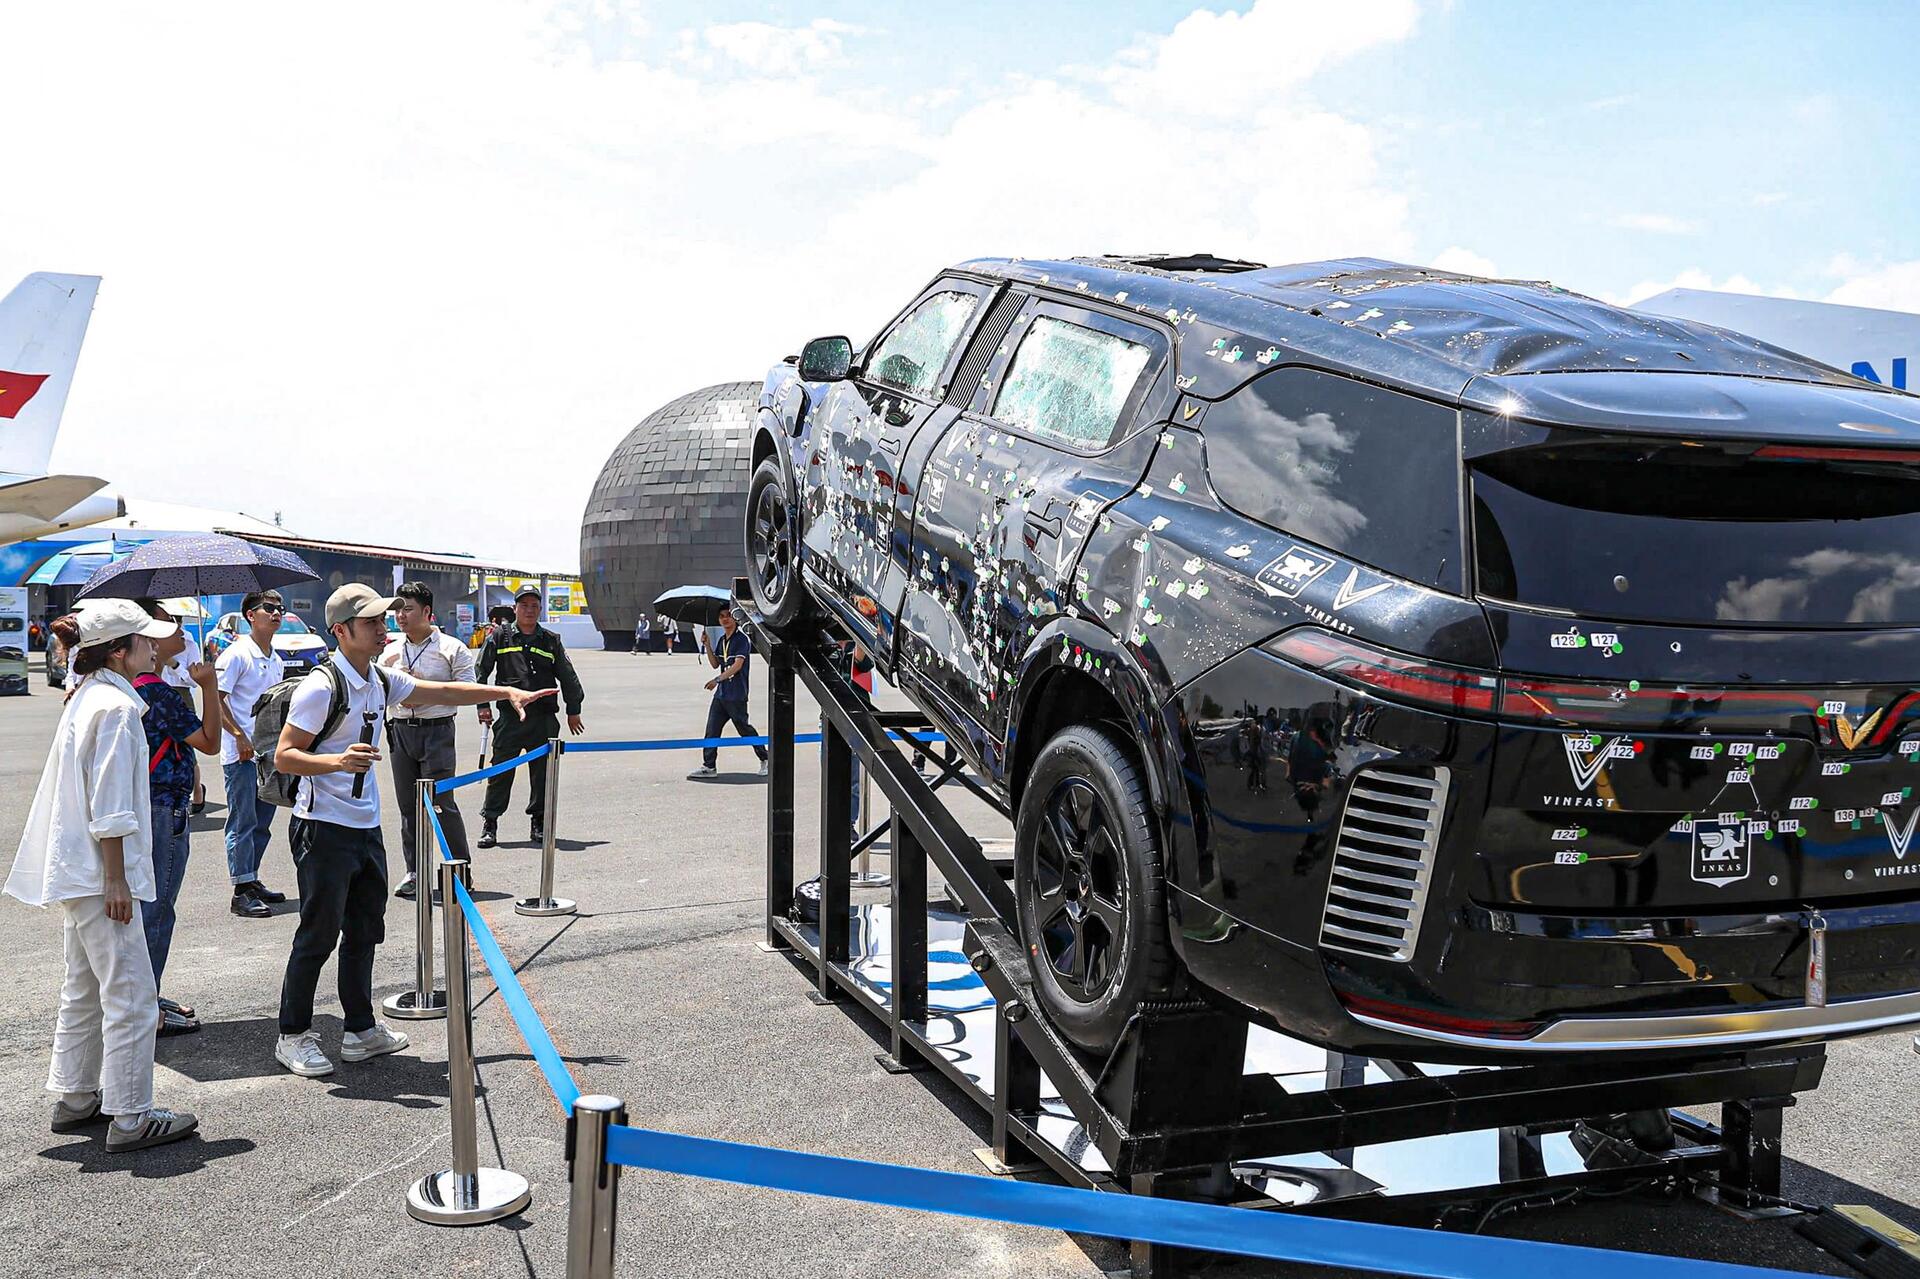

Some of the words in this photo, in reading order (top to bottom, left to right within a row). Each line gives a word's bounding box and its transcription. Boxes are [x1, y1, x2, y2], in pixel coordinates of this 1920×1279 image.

[1264, 571, 1297, 590] INKAS
[1304, 603, 1356, 634] VINFAST
[1554, 635, 1576, 646] 128
[1594, 634, 1615, 645] 127
[1826, 702, 1843, 713] 119
[1570, 740, 1591, 751] 123
[1732, 744, 1750, 755] 121
[1901, 742, 1917, 752] 139
[1613, 746, 1633, 757] 122
[1695, 748, 1712, 758] 115
[1760, 747, 1777, 758] 116
[1826, 764, 1842, 774] 120
[1730, 772, 1748, 782] 109
[1543, 795, 1616, 808] VINFAST
[1793, 799, 1809, 809] 112
[1884, 794, 1900, 804] 135
[1721, 813, 1737, 824] 111
[1839, 810, 1854, 821] 136
[1751, 822, 1767, 833] 113
[1780, 820, 1797, 831] 114
[1556, 829, 1576, 839] 124
[1558, 853, 1579, 864] 125
[1701, 863, 1742, 873] INKAS
